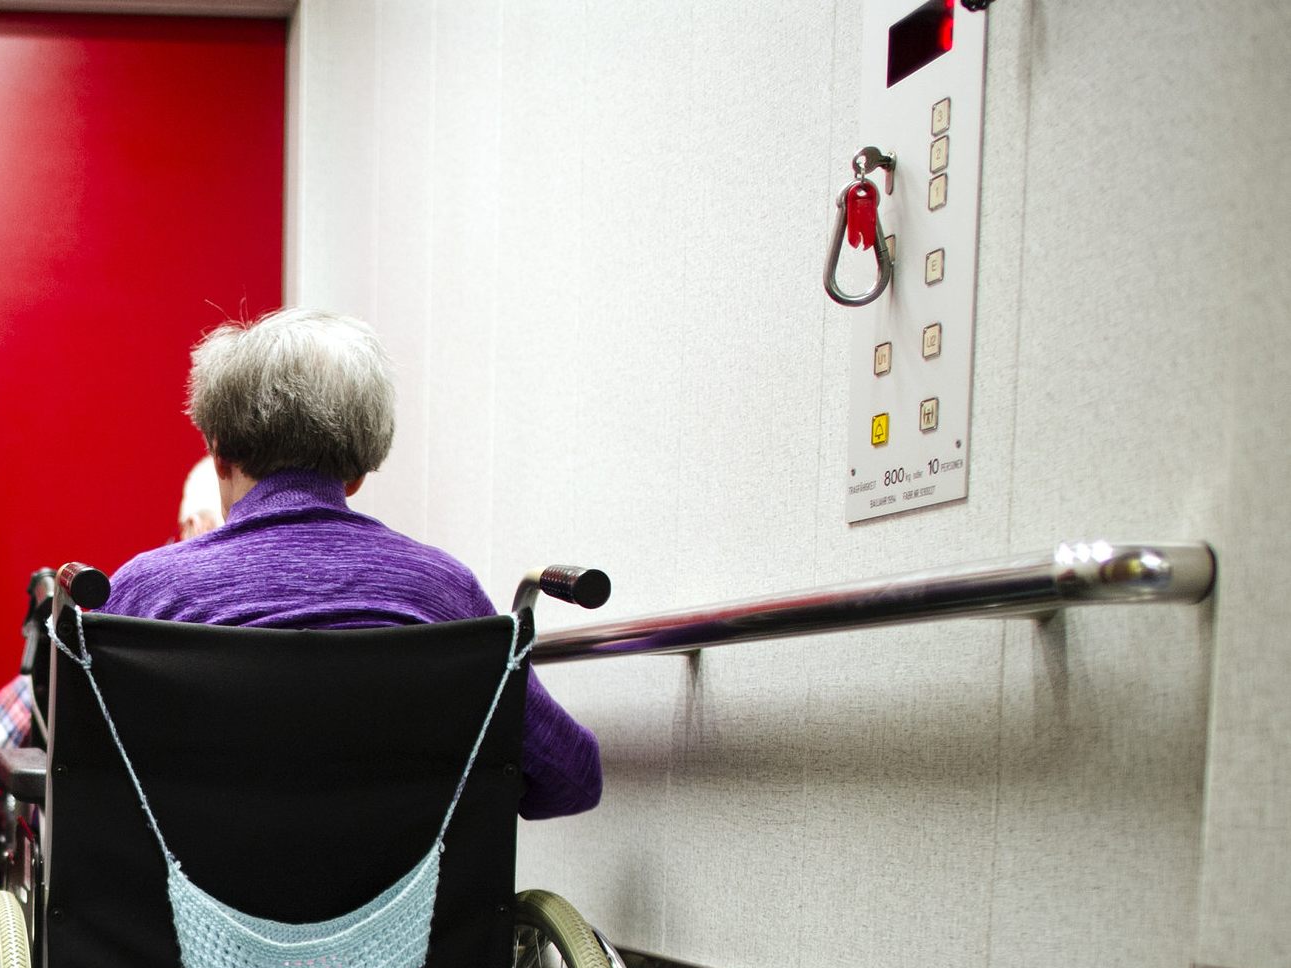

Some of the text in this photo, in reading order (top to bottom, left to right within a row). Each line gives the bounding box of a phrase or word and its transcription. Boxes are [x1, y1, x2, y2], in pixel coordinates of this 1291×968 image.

[931, 259, 938, 272] E
[884, 467, 905, 487] 800
[928, 458, 940, 476] 10
